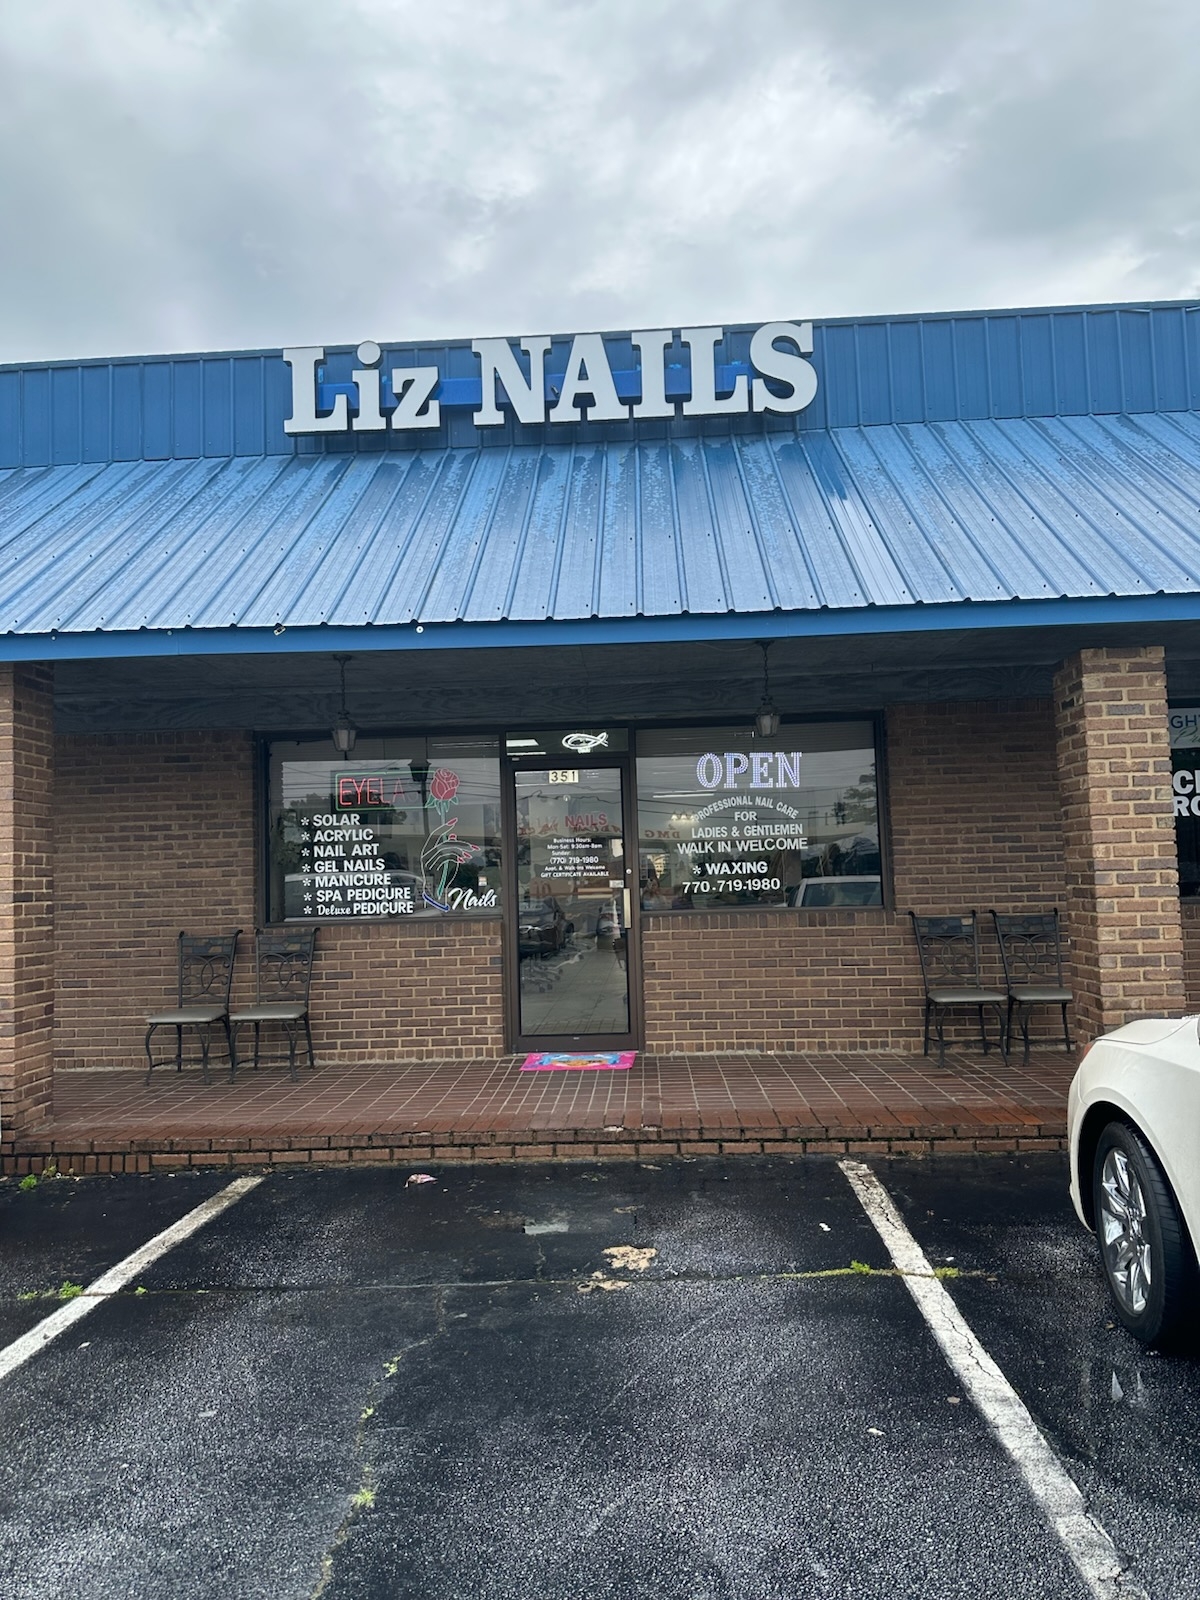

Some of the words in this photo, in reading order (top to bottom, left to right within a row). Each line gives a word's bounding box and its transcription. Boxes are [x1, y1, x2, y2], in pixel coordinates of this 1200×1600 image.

[282, 340, 441, 434] Liz
[471, 321, 819, 428] NAILS
[1170, 714, 1200, 729] GH
[550, 770, 576, 782] 351
[695, 751, 802, 789] OPEN
[694, 795, 753, 824] PROFESSIONAL
[754, 795, 774, 808] NAIL
[776, 801, 799, 820] CARE
[733, 811, 758, 822] FOR
[312, 813, 361, 826] SOLAR
[564, 813, 608, 828] NAILS
[313, 828, 374, 842] ACRYLIC
[691, 826, 728, 839] LADIES
[731, 827, 740, 838] &
[743, 823, 803, 837] GENTLEMEN
[313, 844, 346, 857] NAIL
[351, 843, 379, 856] ART
[676, 842, 715, 855] WALK
[717, 841, 731, 853] IN
[735, 838, 809, 852] WELCOME
[314, 860, 339, 873] GEL
[343, 858, 385, 872] NAILS
[549, 857, 567, 865] (770)
[568, 856, 599, 864] 719-1980
[705, 861, 769, 875] WAXING
[315, 873, 391, 888] MANICURE
[316, 889, 342, 902] SPA
[347, 887, 411, 901] PEDICURE
[448, 887, 498, 911] Nails
[316, 904, 352, 916] Deluxe
[353, 901, 414, 915] PEDICURE
